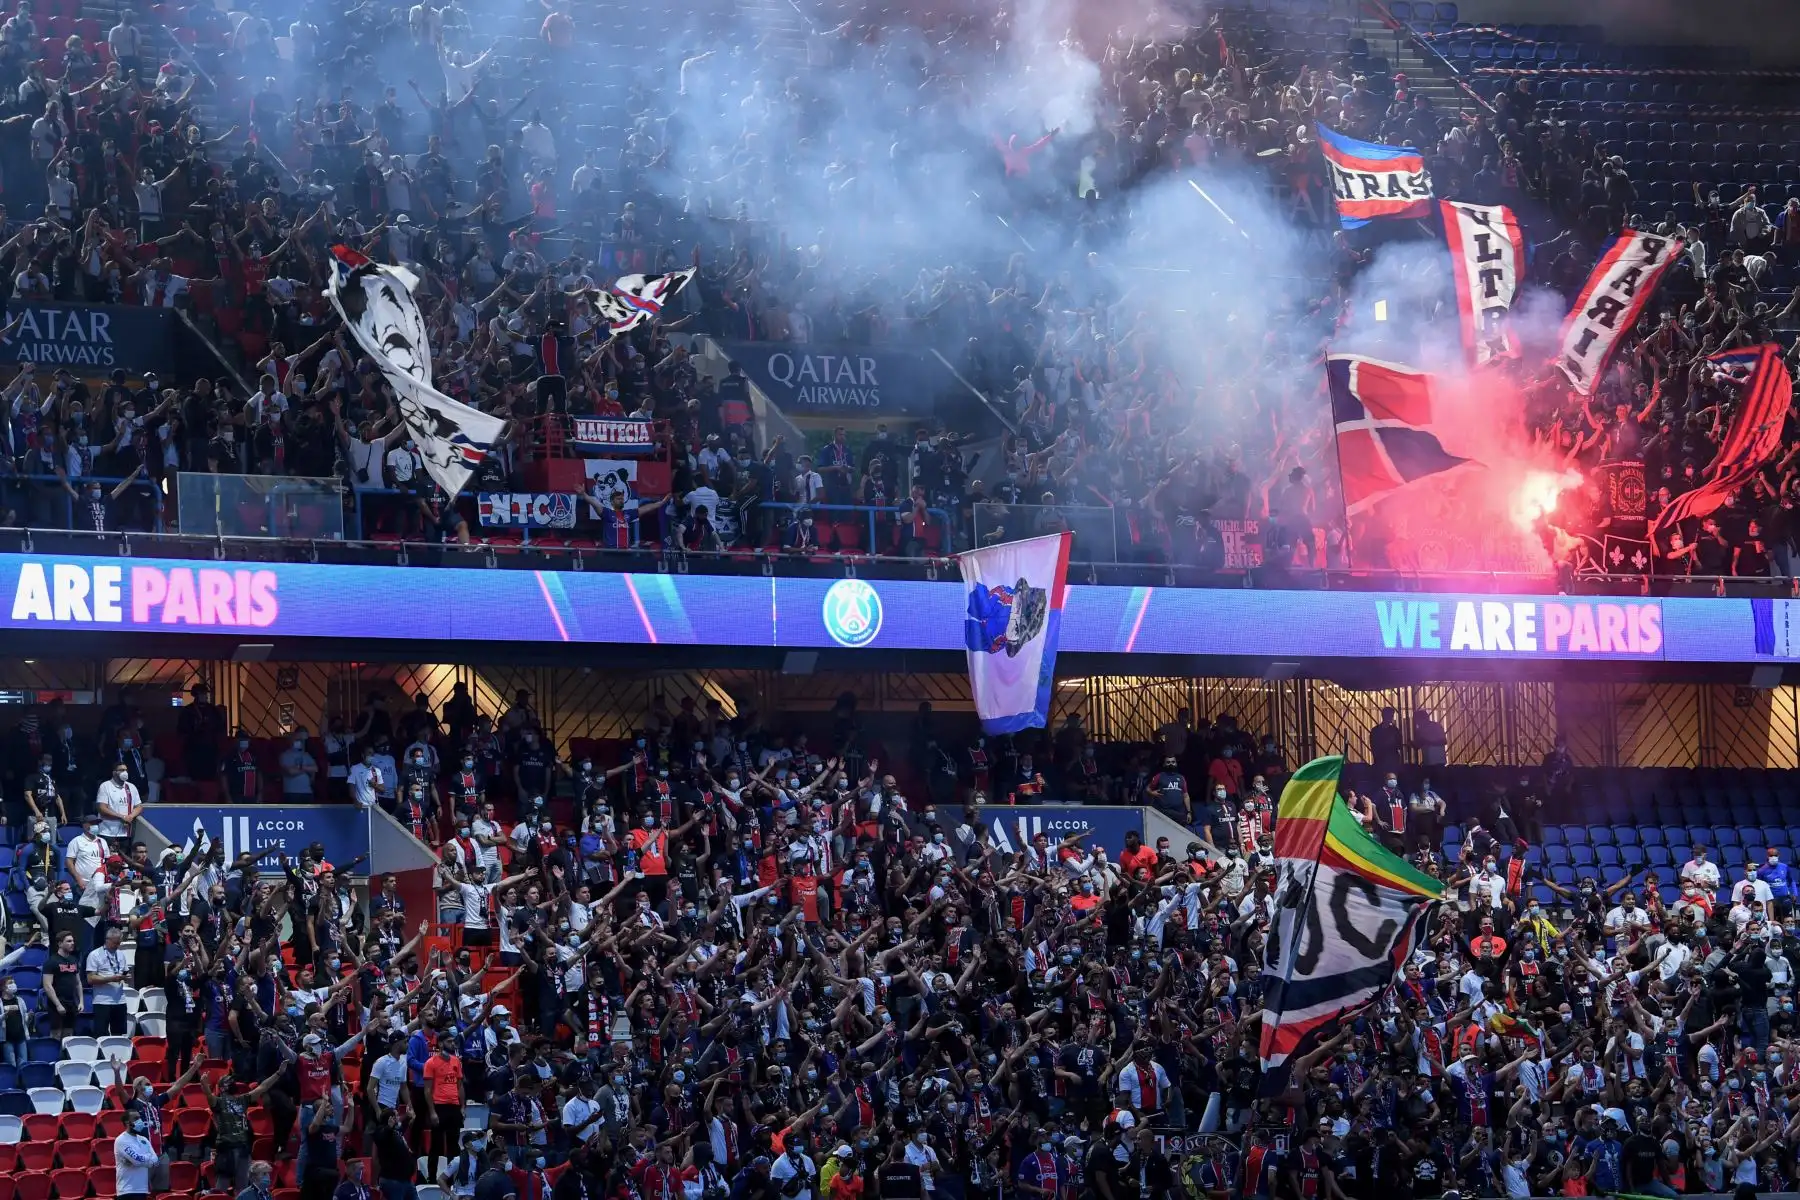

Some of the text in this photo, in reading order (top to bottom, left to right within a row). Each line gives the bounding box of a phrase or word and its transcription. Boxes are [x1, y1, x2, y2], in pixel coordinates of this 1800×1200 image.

[17, 342, 114, 366] AIRWAYS
[768, 353, 879, 389] QATAR
[797, 386, 880, 407] AIRWAYS
[11, 563, 278, 627] ARE PARIS
[1375, 600, 1662, 653] WE ARE PARIS
[256, 821, 305, 831] ACCOR
[1047, 820, 1089, 830] ACCOR
[256, 838, 286, 849] LIVE
